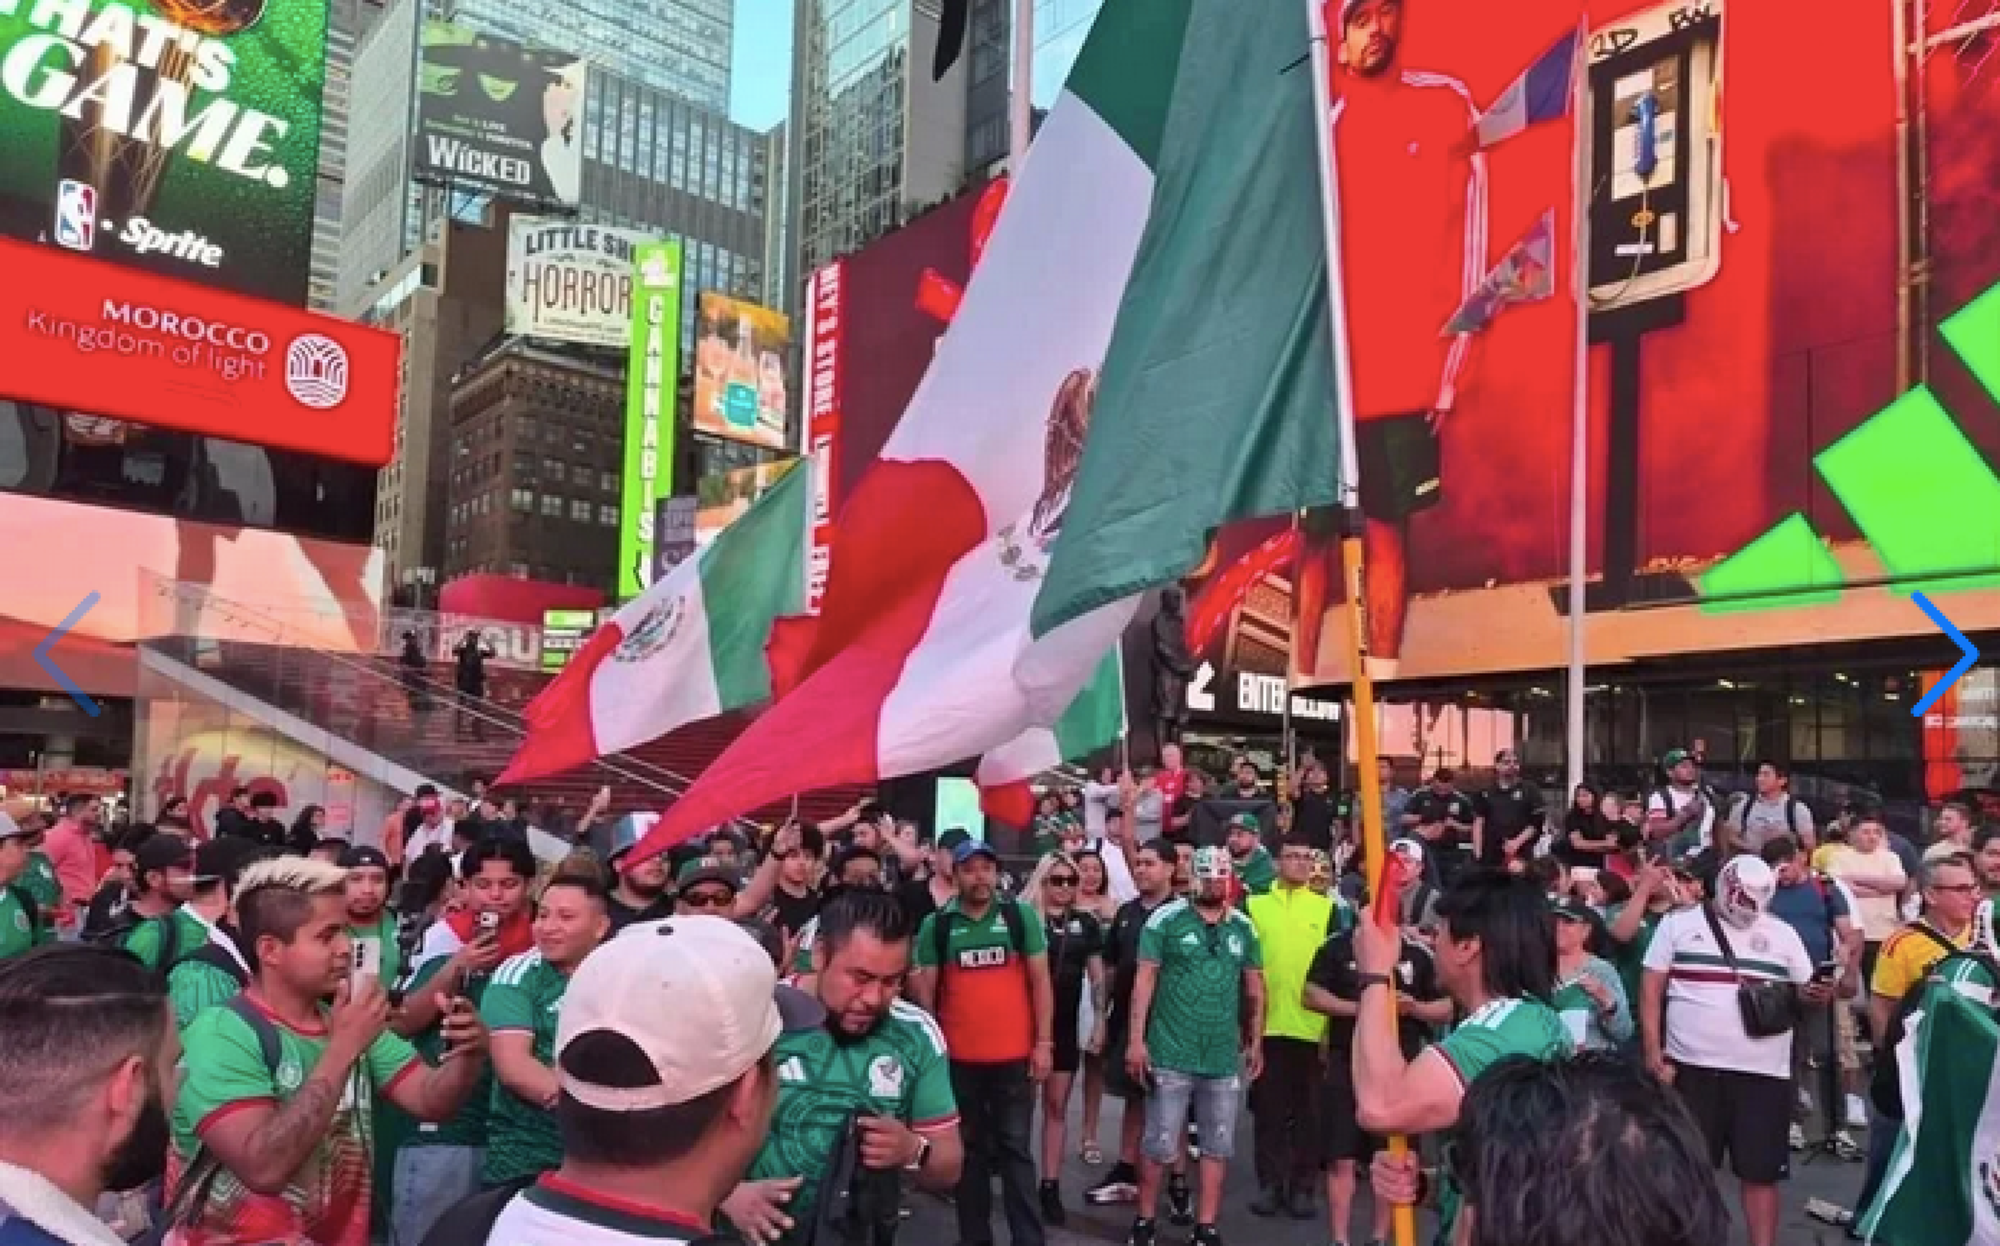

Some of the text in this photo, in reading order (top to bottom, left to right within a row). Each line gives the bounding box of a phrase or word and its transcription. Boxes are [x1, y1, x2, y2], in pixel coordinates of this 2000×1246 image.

[0, 0, 237, 92] HAT'S
[1, 33, 290, 188] GAME.
[118, 216, 222, 267] Sprite
[525, 226, 599, 256] LITTLE
[603, 232, 633, 263] SH
[28, 310, 268, 380] Kingdom of light
[102, 298, 270, 354] MOROCCO
[636, 294, 664, 545] CANNABIS
